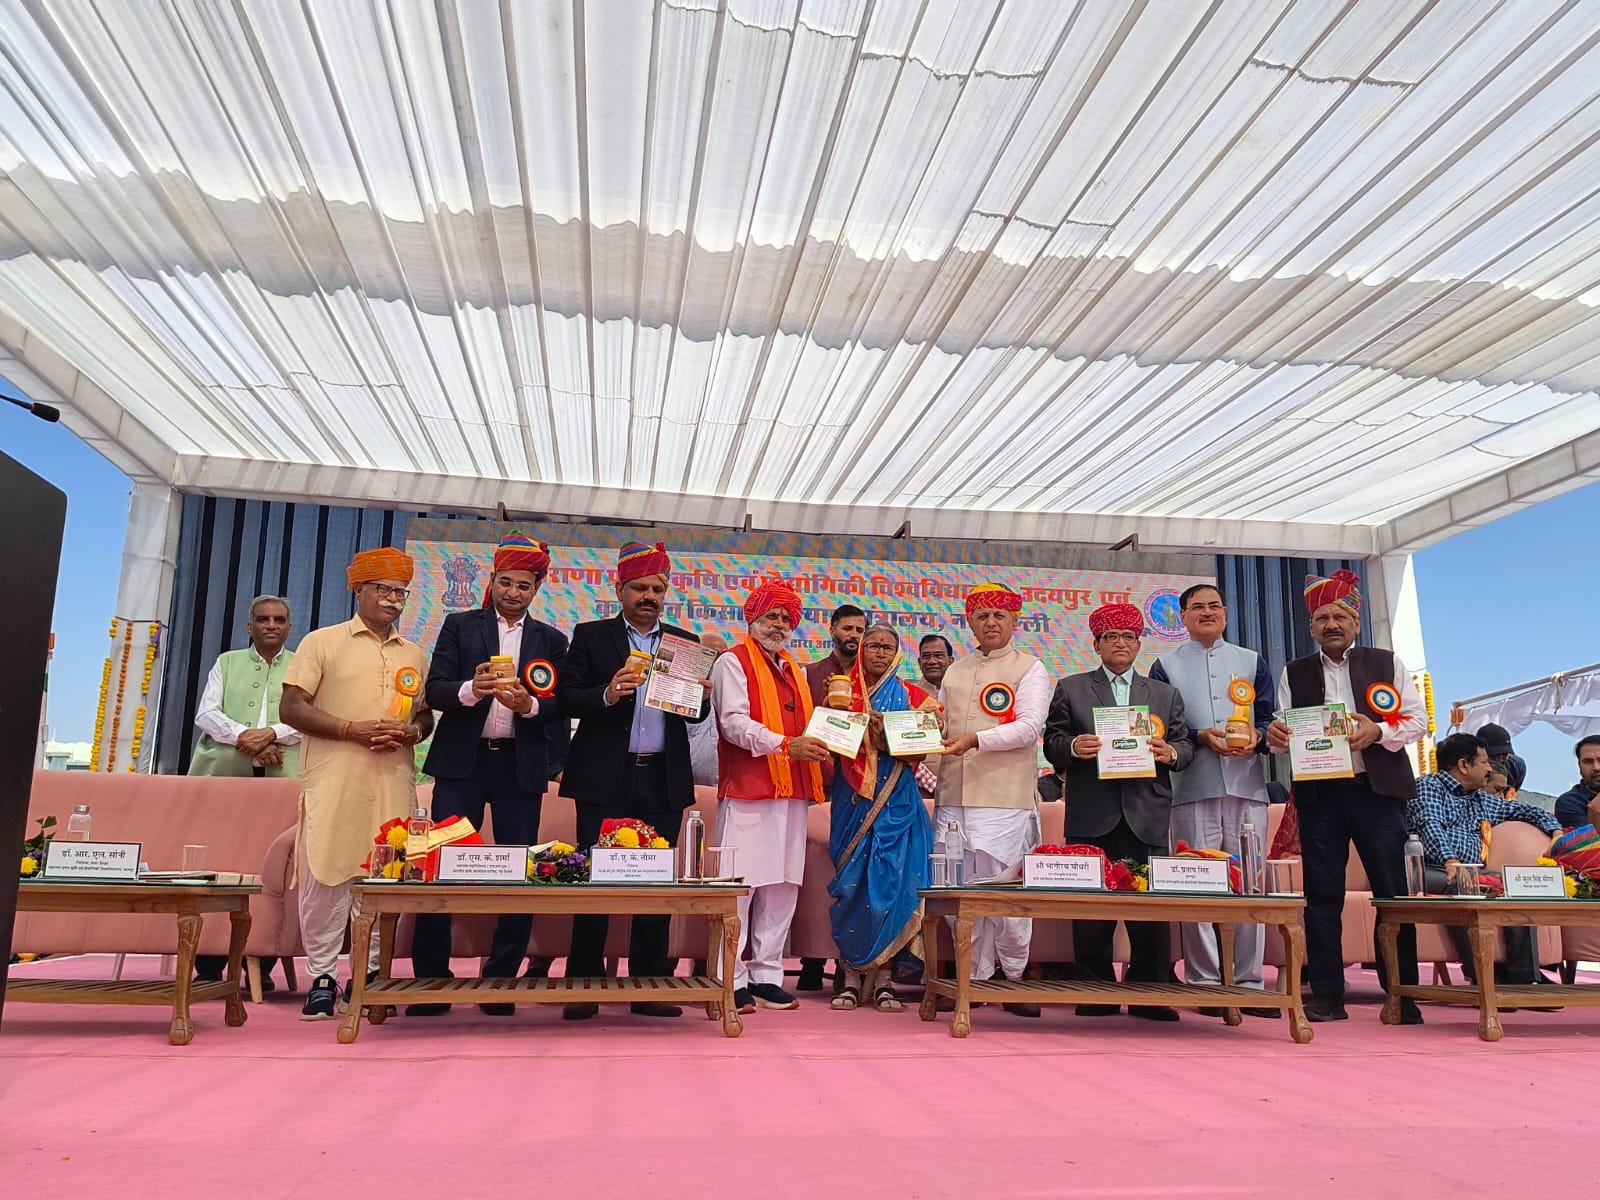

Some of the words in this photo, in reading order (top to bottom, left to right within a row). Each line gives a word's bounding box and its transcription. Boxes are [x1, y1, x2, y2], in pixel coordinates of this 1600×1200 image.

[671, 569, 720, 593] कृषि
[1020, 586, 1091, 610] उदयपुर
[74, 850, 90, 858] आर.
[92, 851, 107, 860] एल.
